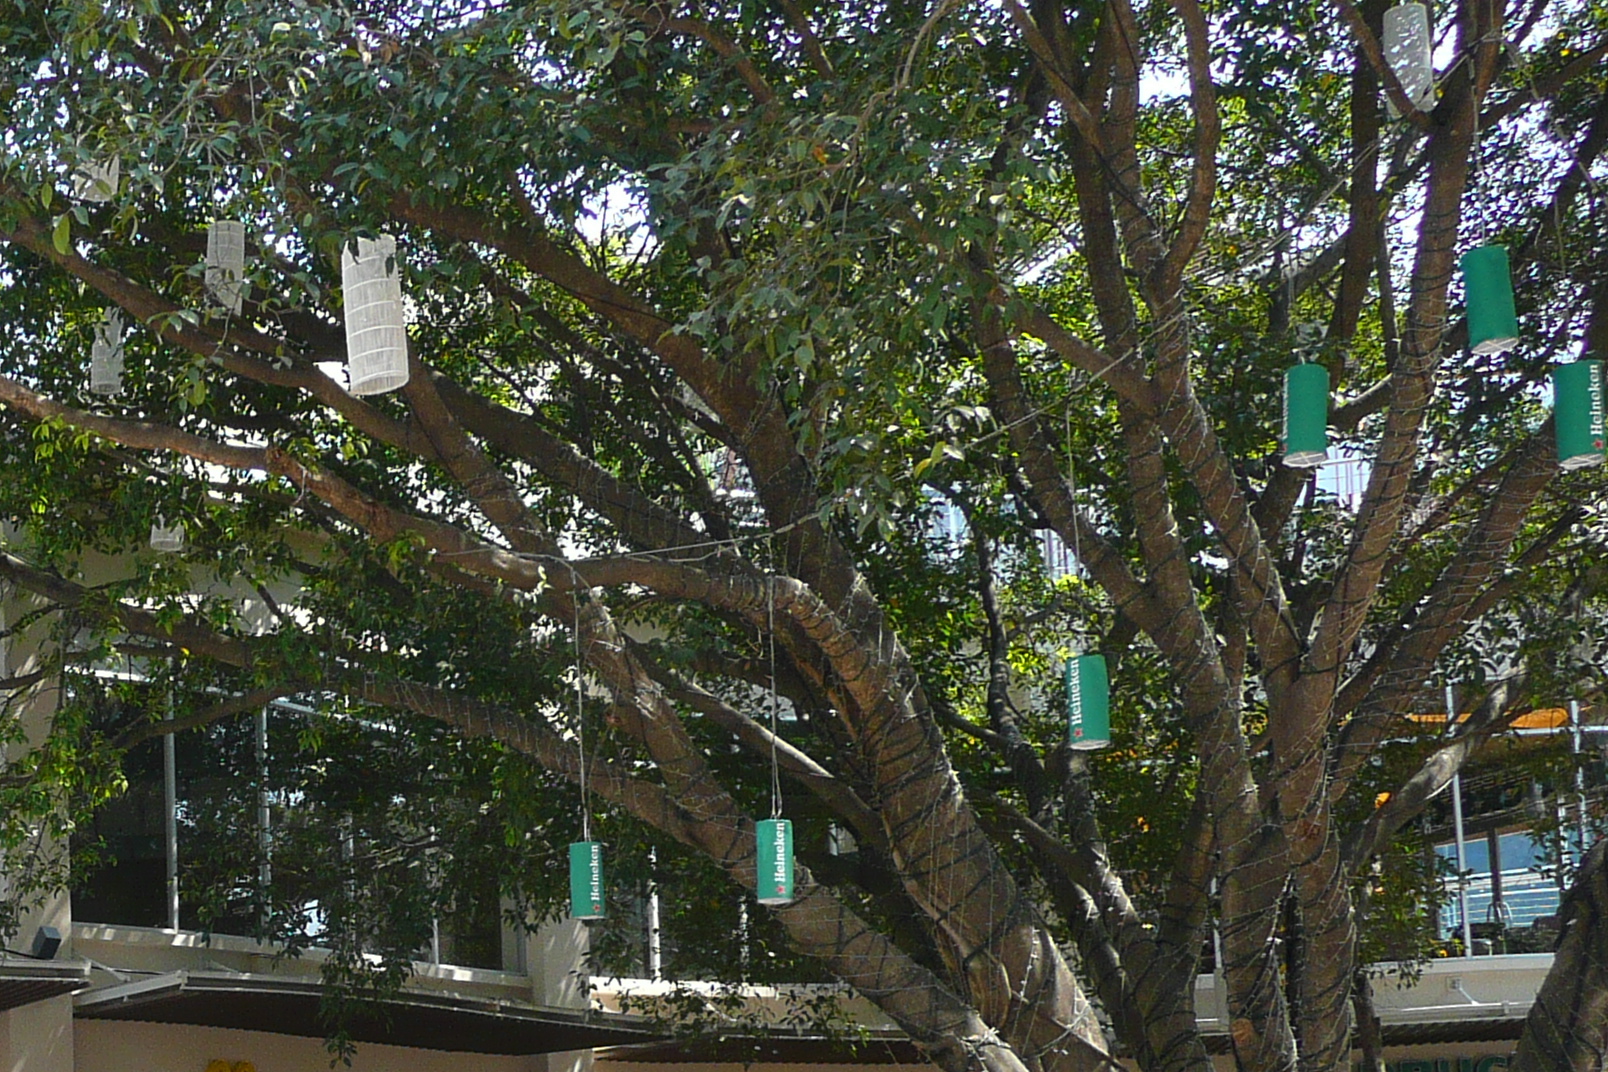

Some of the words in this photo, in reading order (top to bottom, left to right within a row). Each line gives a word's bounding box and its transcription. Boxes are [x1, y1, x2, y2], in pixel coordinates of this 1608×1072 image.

[1587, 364, 1603, 436] Heineken
[1069, 658, 1081, 726] Heineken
[588, 844, 601, 902] Heineken
[773, 822, 787, 883] Heineken
